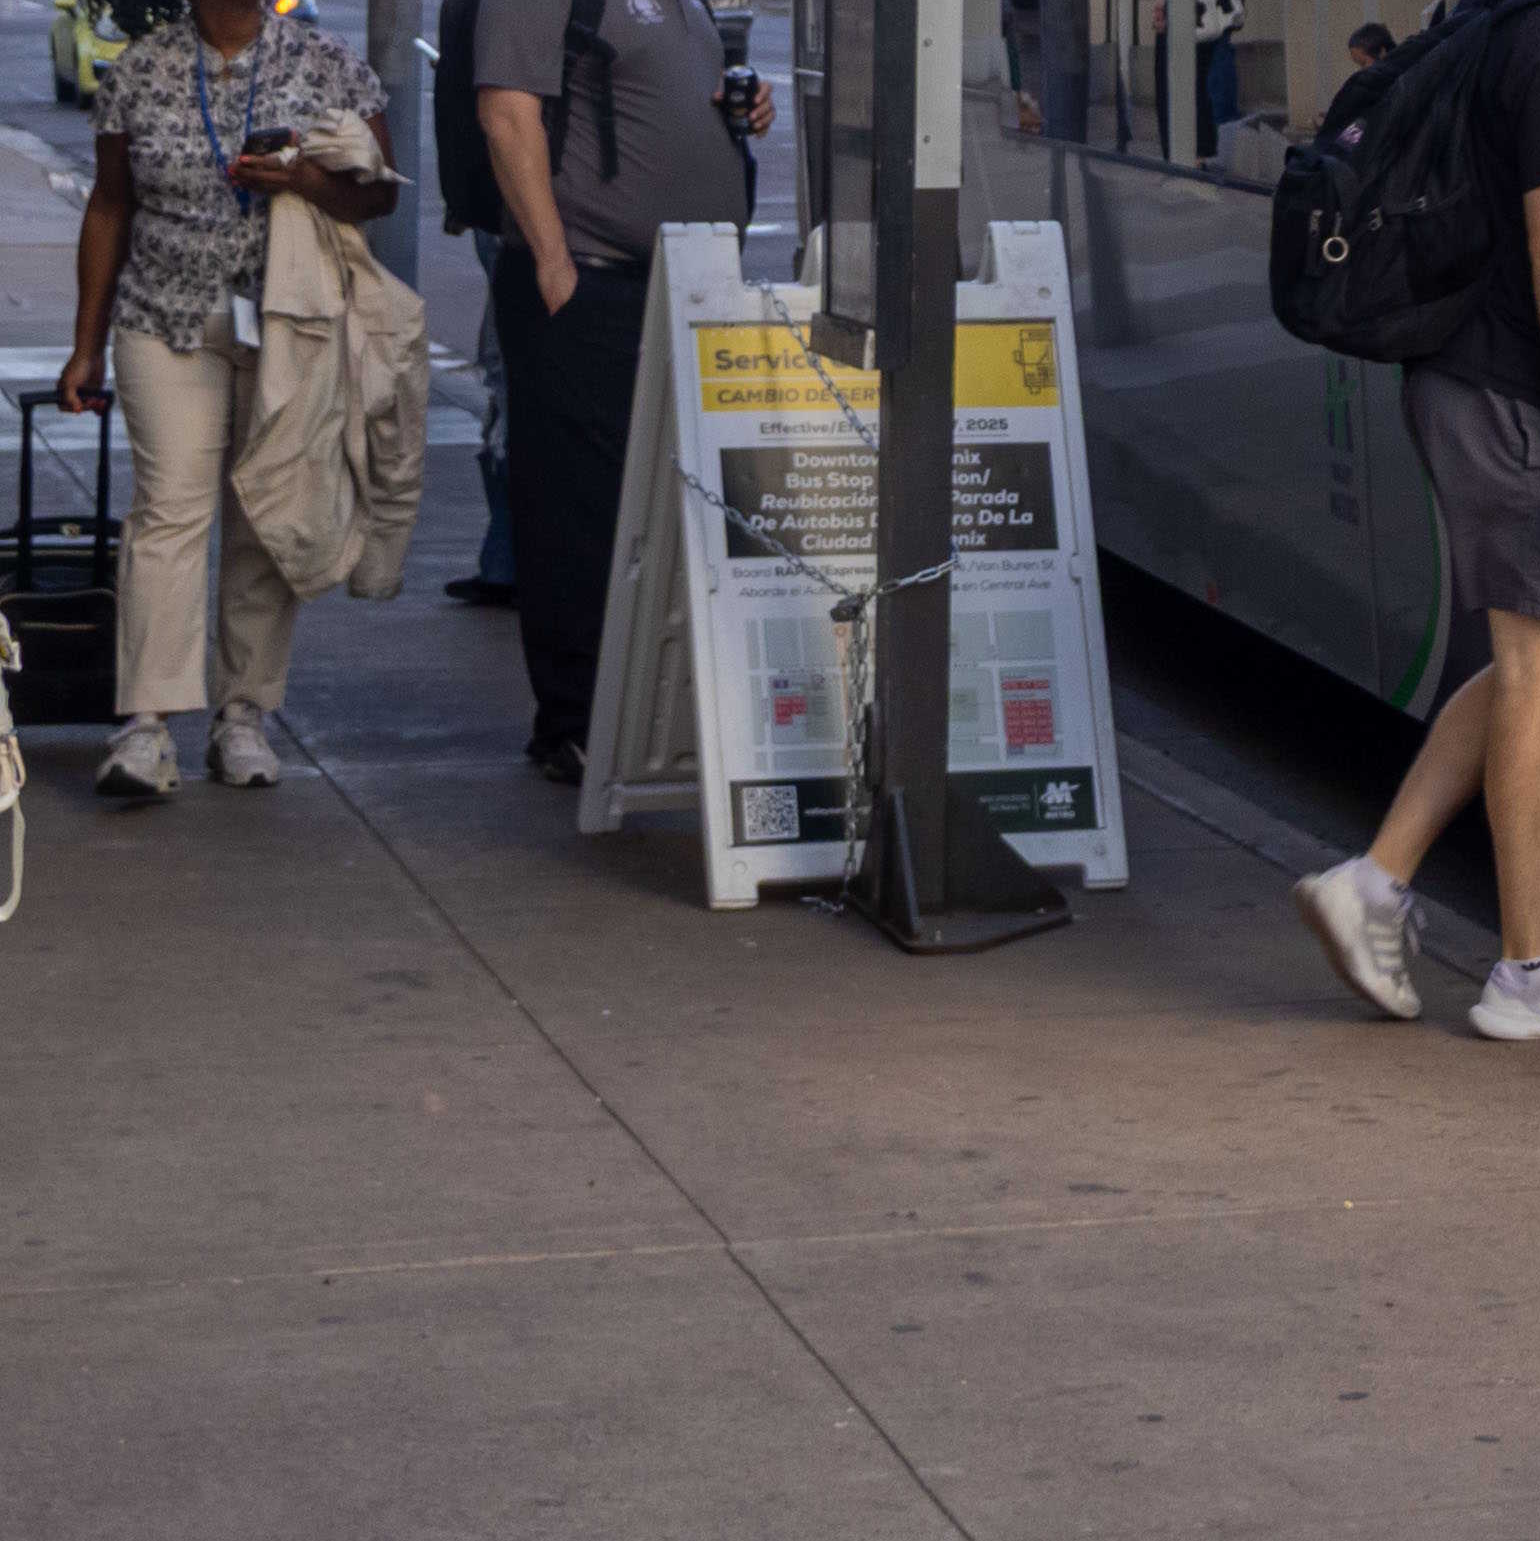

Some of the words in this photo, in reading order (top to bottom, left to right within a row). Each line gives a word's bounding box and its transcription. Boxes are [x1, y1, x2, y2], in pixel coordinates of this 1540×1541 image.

[714, 348, 819, 371] Servic
[717, 387, 799, 404] CAMBIO
[966, 417, 1009, 431] 2025
[785, 472, 823, 489] Bus
[827, 471, 873, 491] Stop
[750, 514, 777, 531] De
[781, 511, 865, 531] Autobús
[977, 508, 1005, 525] De
[1008, 508, 1034, 524] La
[801, 533, 873, 551] Ciudad
